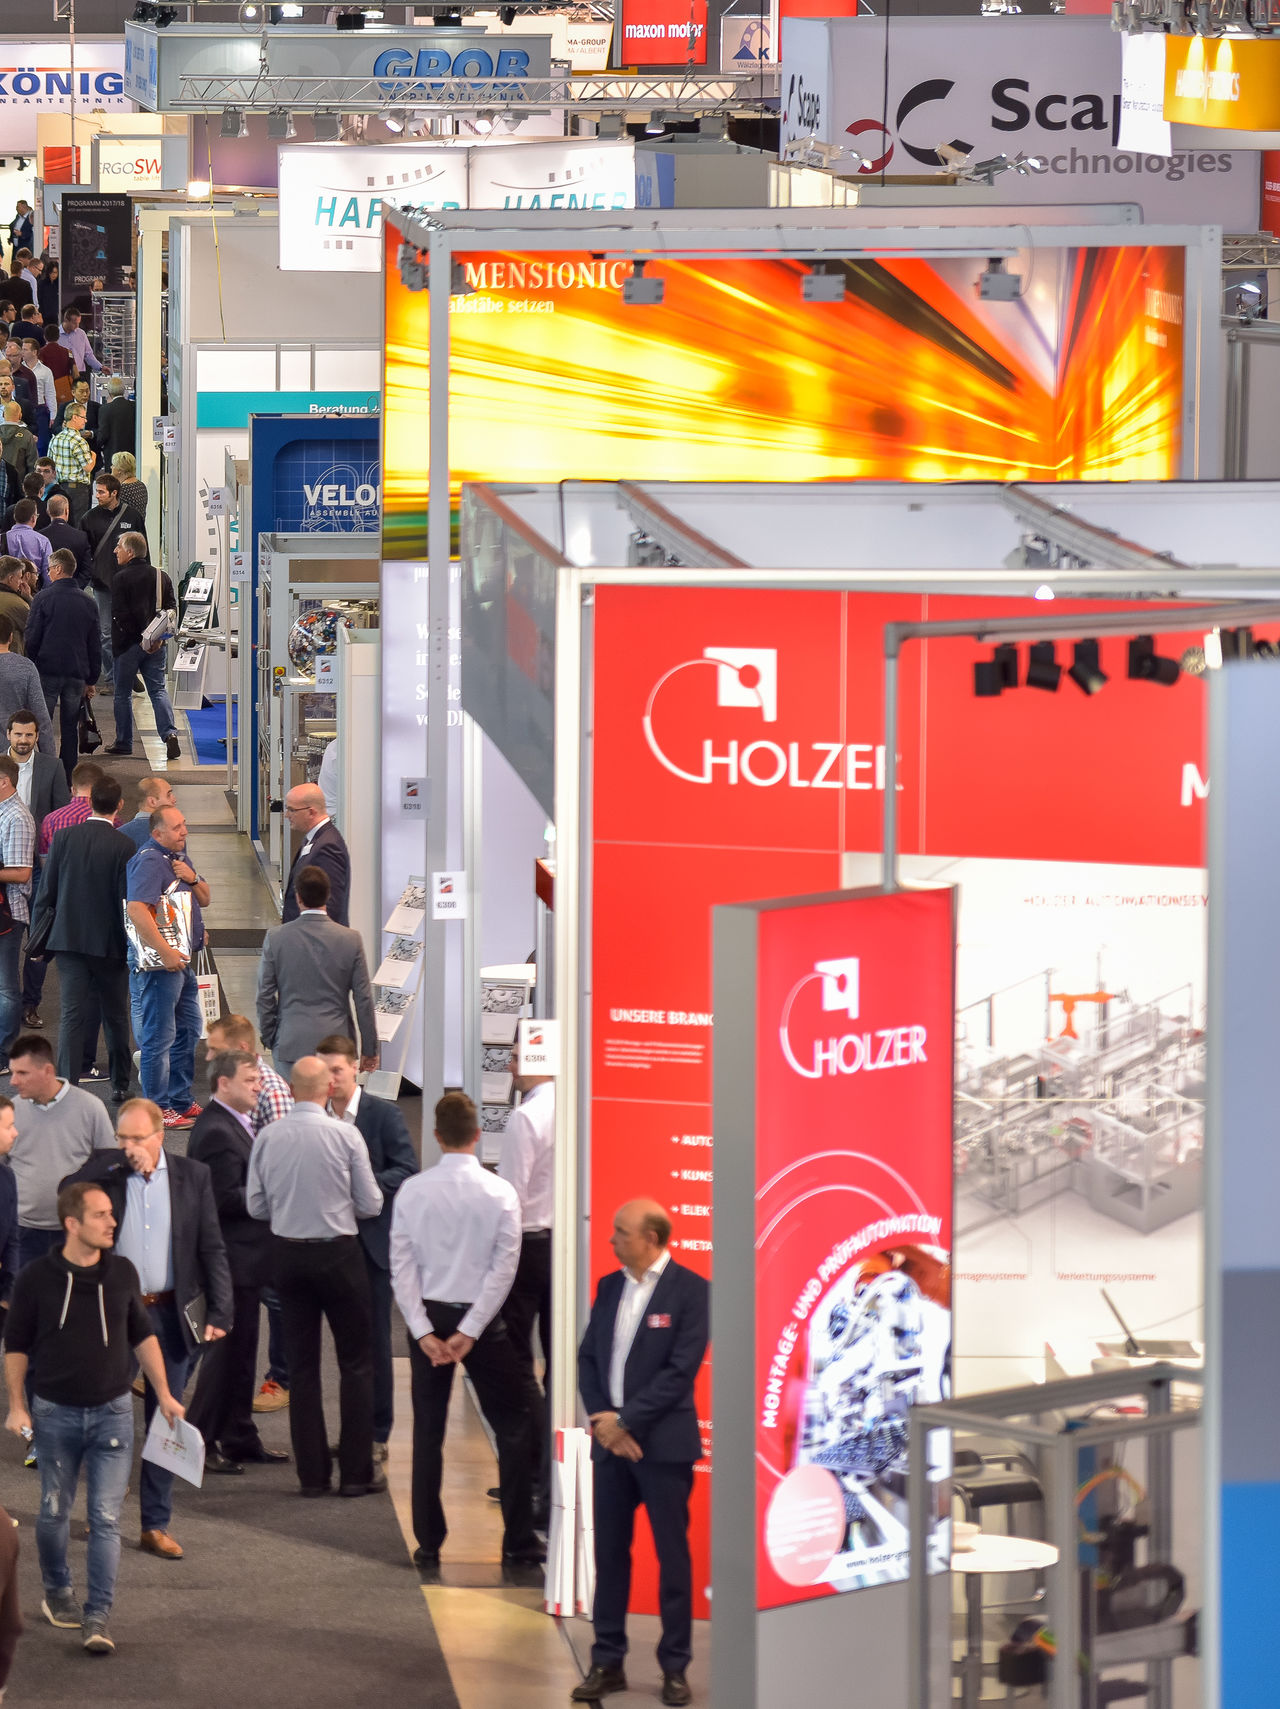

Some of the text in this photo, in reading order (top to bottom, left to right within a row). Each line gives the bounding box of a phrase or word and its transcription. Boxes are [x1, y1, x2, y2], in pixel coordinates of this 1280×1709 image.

[625, 22, 703, 38] maxon motor
[373, 48, 530, 90] GROB
[465, 261, 634, 290] MENSIONIC
[507, 298, 554, 314] setzen
[703, 739, 905, 790] HOLZER
[609, 1008, 666, 1025] UNSERE
[814, 1024, 928, 1078] HOLZER
[680, 1203, 713, 1217] ELEK
[761, 1322, 799, 1429] MONTAGE-
[791, 1278, 823, 1321] UND
